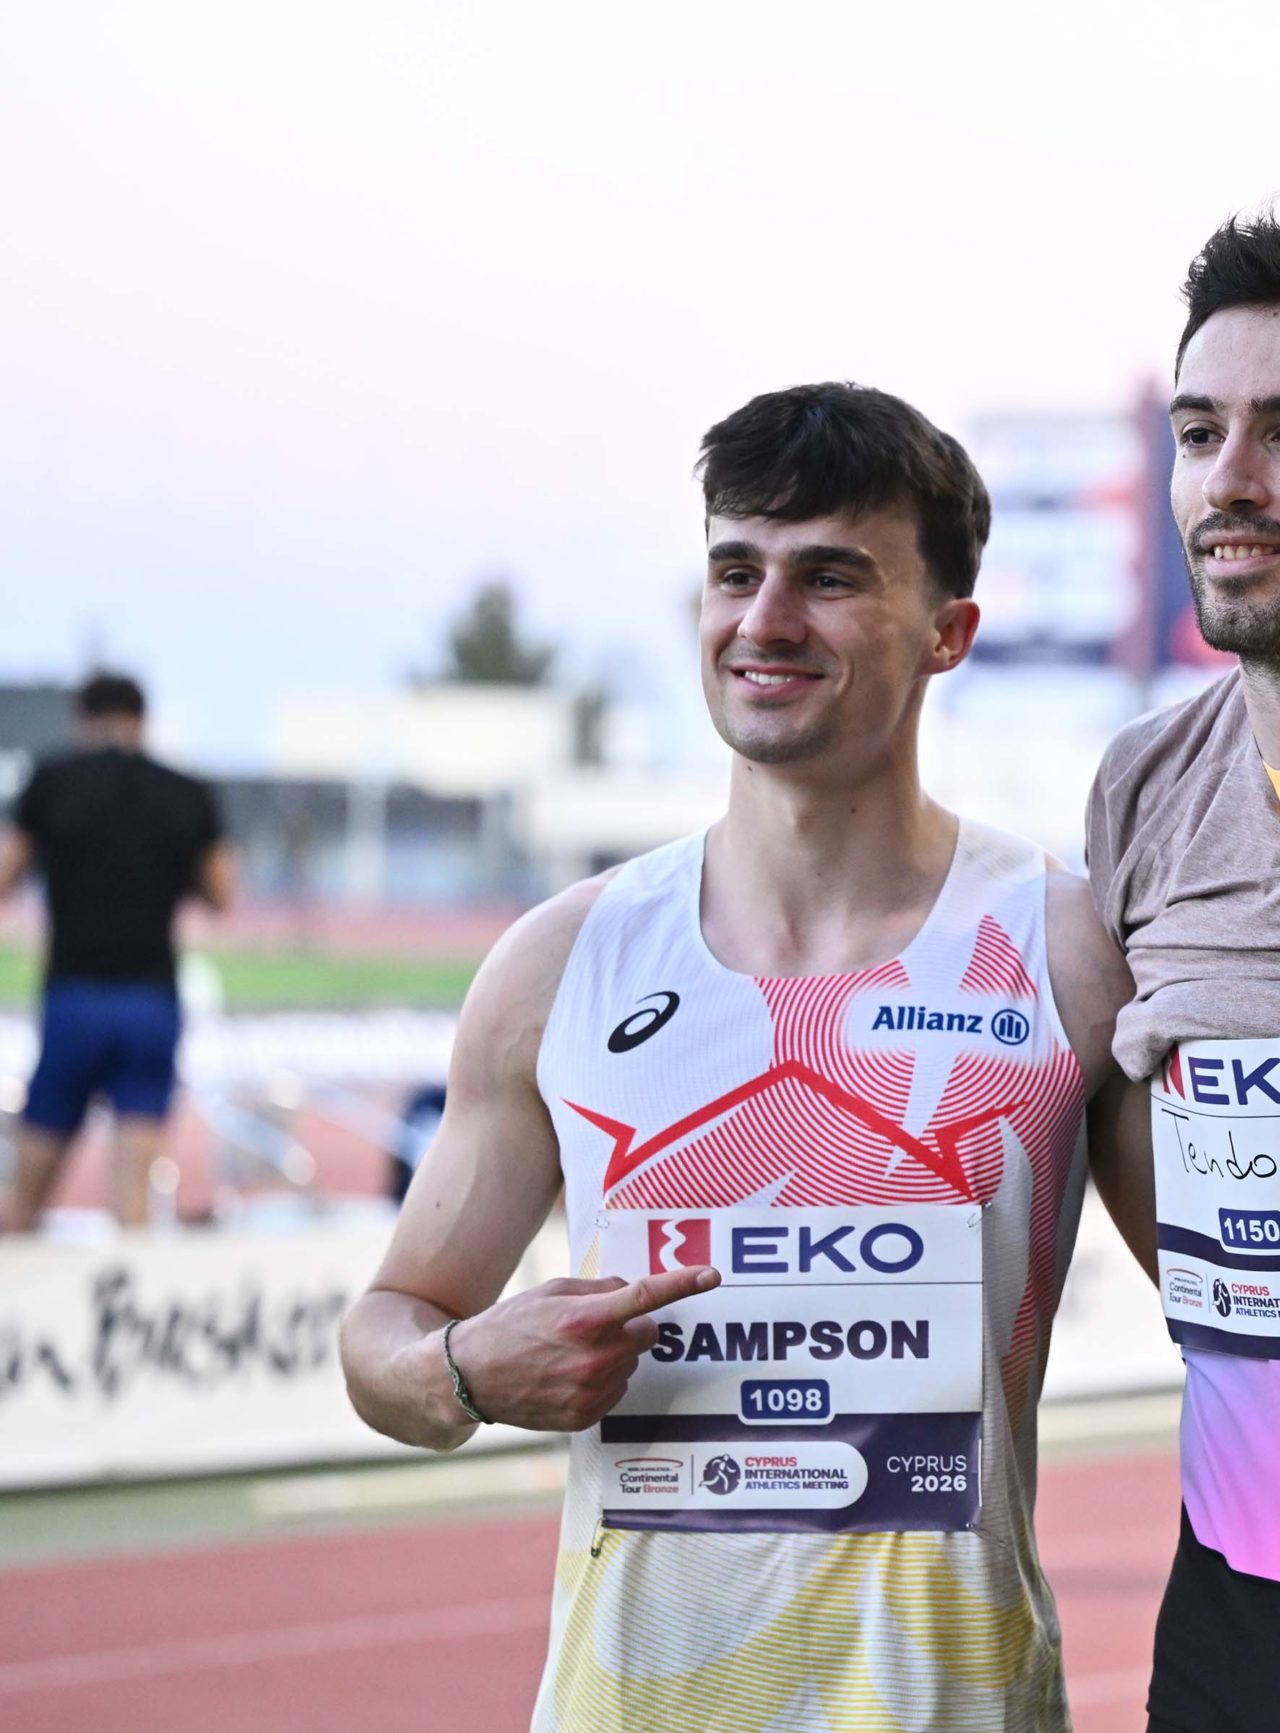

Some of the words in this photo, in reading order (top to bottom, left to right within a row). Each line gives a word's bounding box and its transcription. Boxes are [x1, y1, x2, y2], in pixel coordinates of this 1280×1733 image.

[872, 1006, 983, 1034] Allianz
[1223, 1218, 1280, 1242] 1150
[731, 1222, 924, 1273] EKO
[1231, 1283, 1270, 1296] CYPRUS
[1235, 1307, 1276, 1318] ATHLETICS
[651, 1319, 930, 1362] SAMPSON
[750, 1388, 822, 1411] 1098
[744, 1457, 797, 1467] CYPRUS
[886, 1455, 967, 1474] CYPRUS
[619, 1473, 679, 1482] Continental
[744, 1469, 847, 1479] INTERNATIONAL
[620, 1483, 641, 1493] Tour
[643, 1485, 679, 1493] Bronze
[745, 1481, 800, 1490] ATHLETICS
[802, 1481, 849, 1490] MEETING
[911, 1475, 967, 1492] 2026
